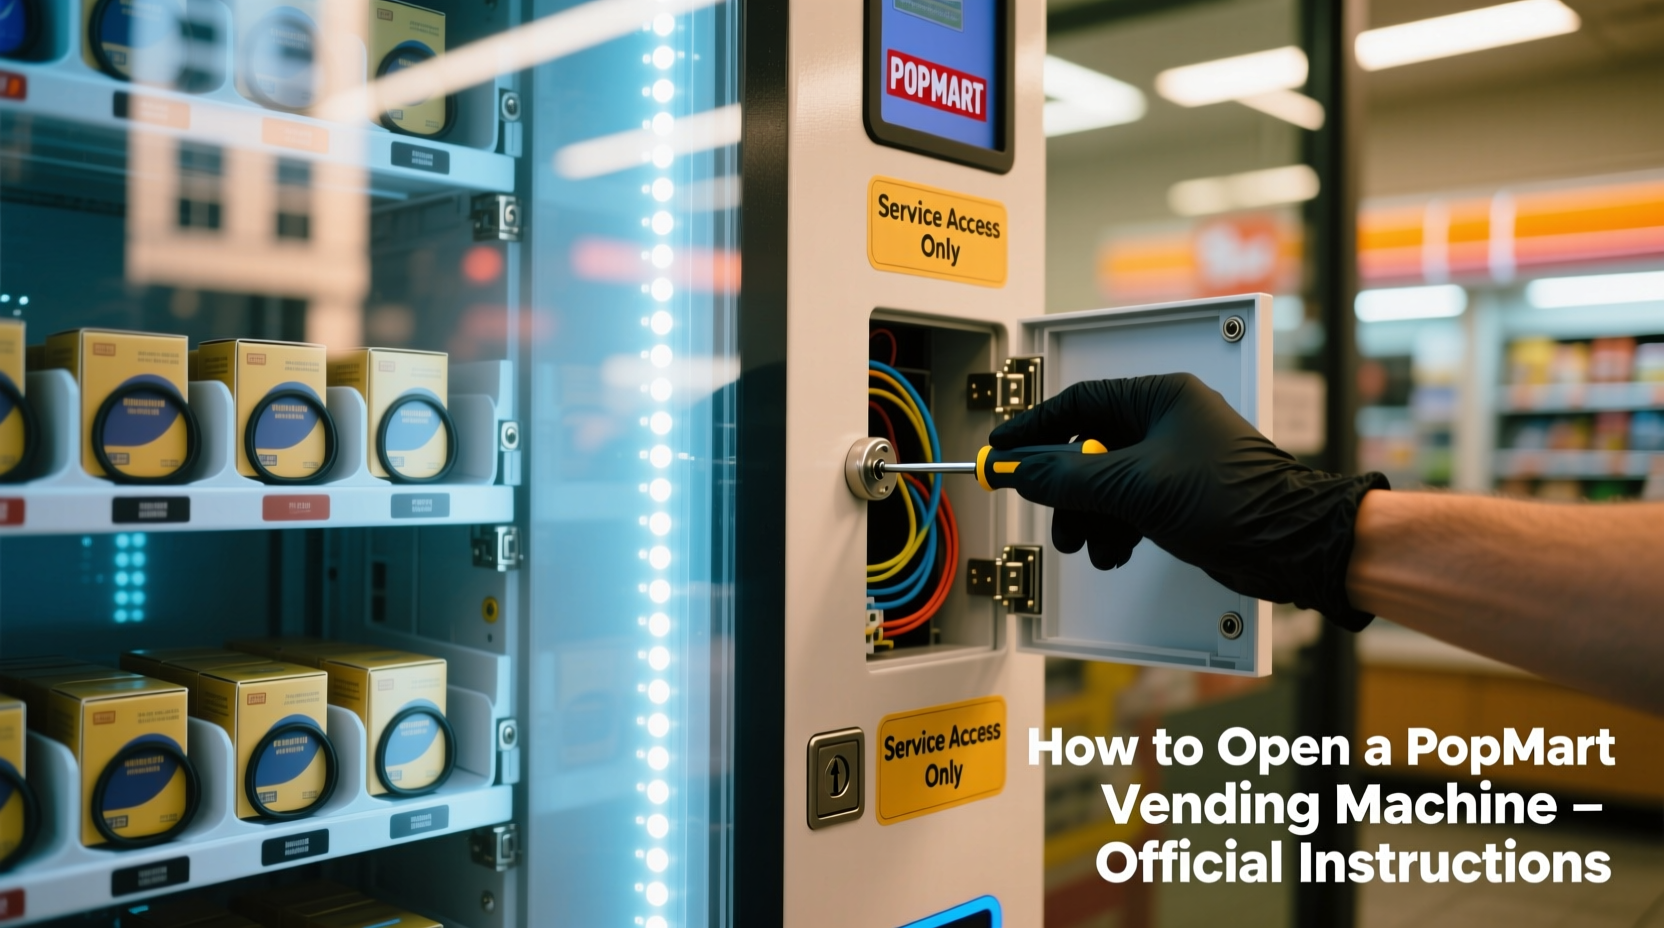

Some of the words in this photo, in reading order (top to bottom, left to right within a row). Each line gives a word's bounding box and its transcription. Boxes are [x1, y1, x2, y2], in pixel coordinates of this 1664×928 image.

[889, 56, 985, 115] POPMART
[878, 193, 943, 228] Service
[946, 207, 1001, 239] Access
[920, 233, 961, 267] Only
[884, 730, 945, 761] Service
[948, 723, 1001, 749] Access
[924, 759, 964, 789] Only
